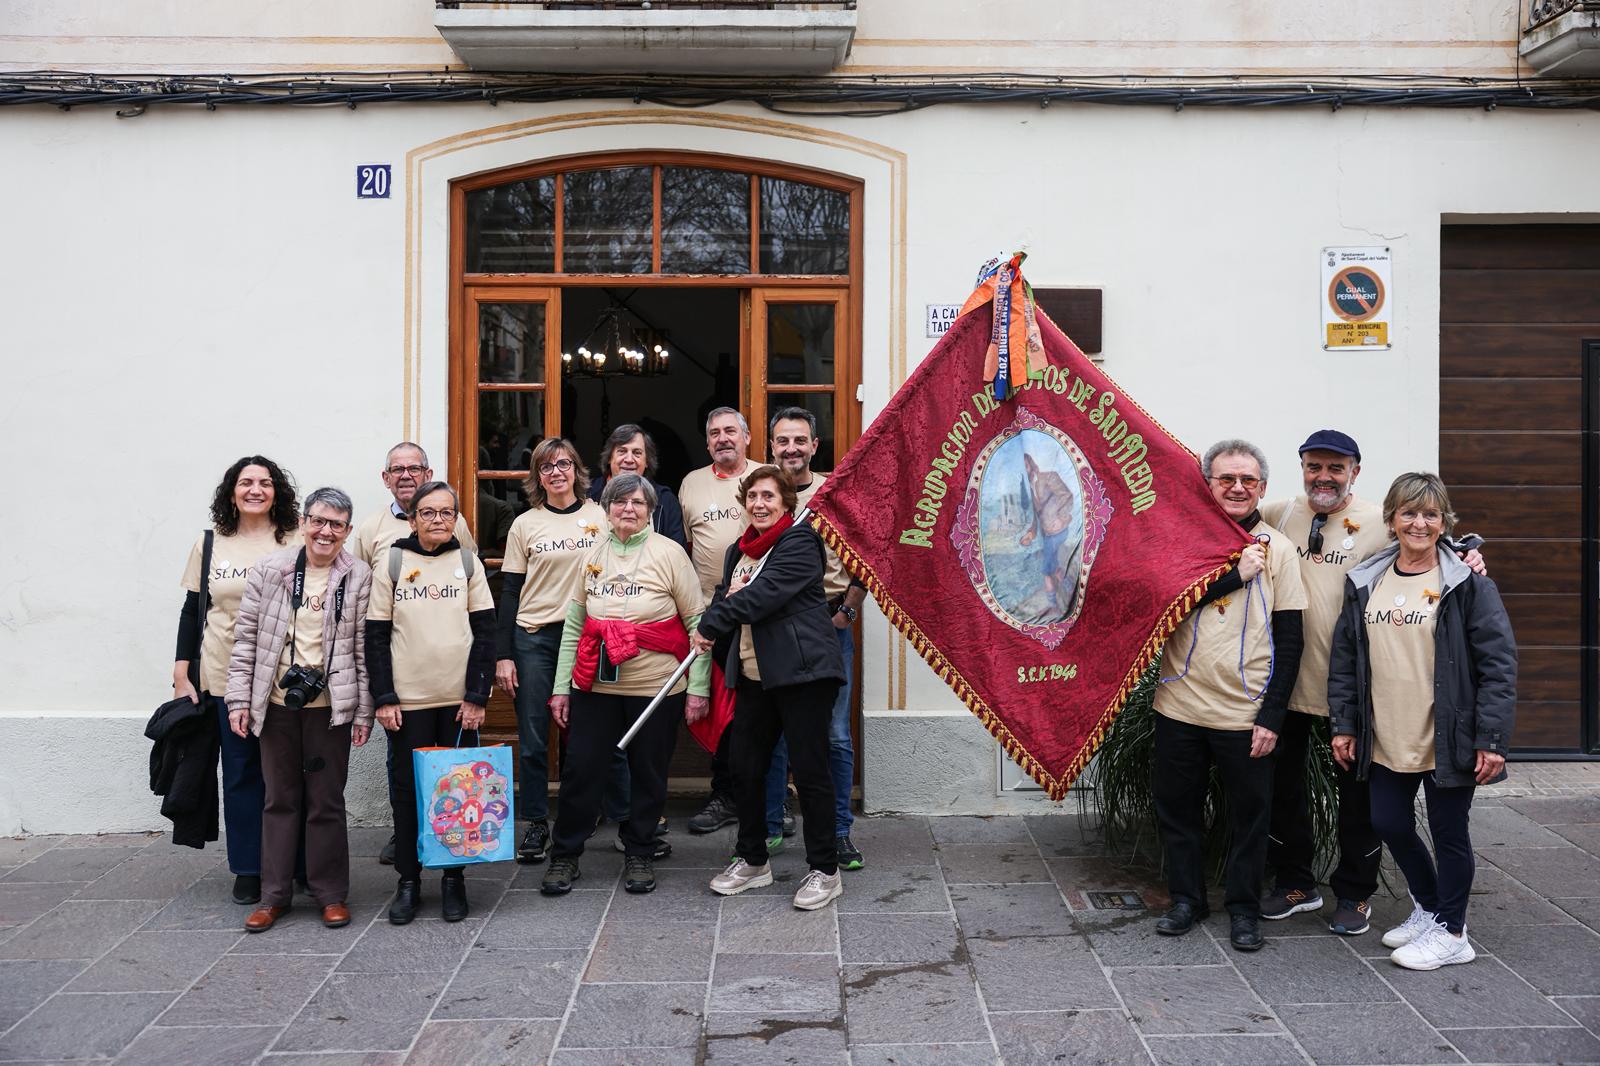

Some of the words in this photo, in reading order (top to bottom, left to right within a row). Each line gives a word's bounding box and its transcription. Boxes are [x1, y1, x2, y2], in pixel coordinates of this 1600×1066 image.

[361, 168, 386, 195] 20
[931, 309, 938, 319] A
[998, 325, 1008, 355] MEDIR
[999, 356, 1008, 380] 2012
[971, 383, 1001, 418] DE
[1066, 376, 1096, 413] DE
[1089, 391, 1128, 447] SAN
